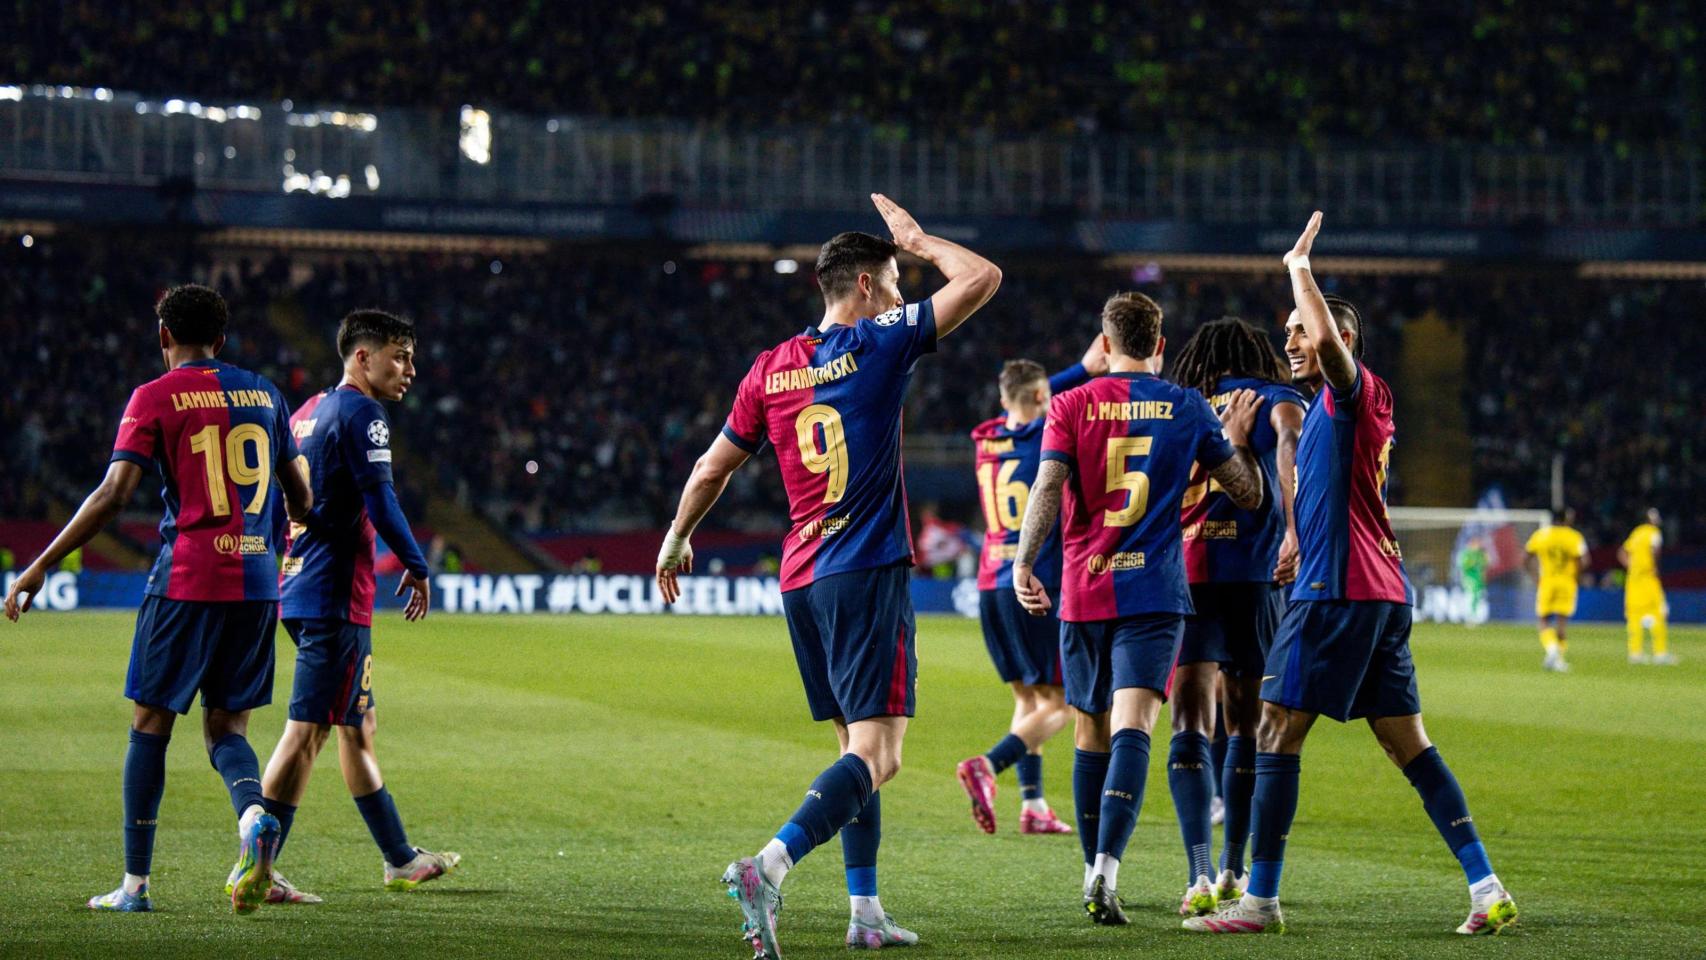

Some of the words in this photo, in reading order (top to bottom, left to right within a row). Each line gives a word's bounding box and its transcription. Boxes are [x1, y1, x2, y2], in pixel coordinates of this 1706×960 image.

[765, 352, 858, 395] LEWANDOWSKI
[171, 391, 228, 411] LAMINE
[227, 389, 273, 409] YAMAL
[1098, 401, 1174, 421] MARTINEZ
[190, 423, 270, 517] 19
[795, 404, 849, 504] 9
[976, 459, 1029, 533] 16
[1103, 436, 1153, 527] 5
[240, 535, 265, 544] UNHCR
[1202, 520, 1237, 529] UNHCR
[436, 575, 543, 613] THAT
[361, 654, 372, 691] 8
